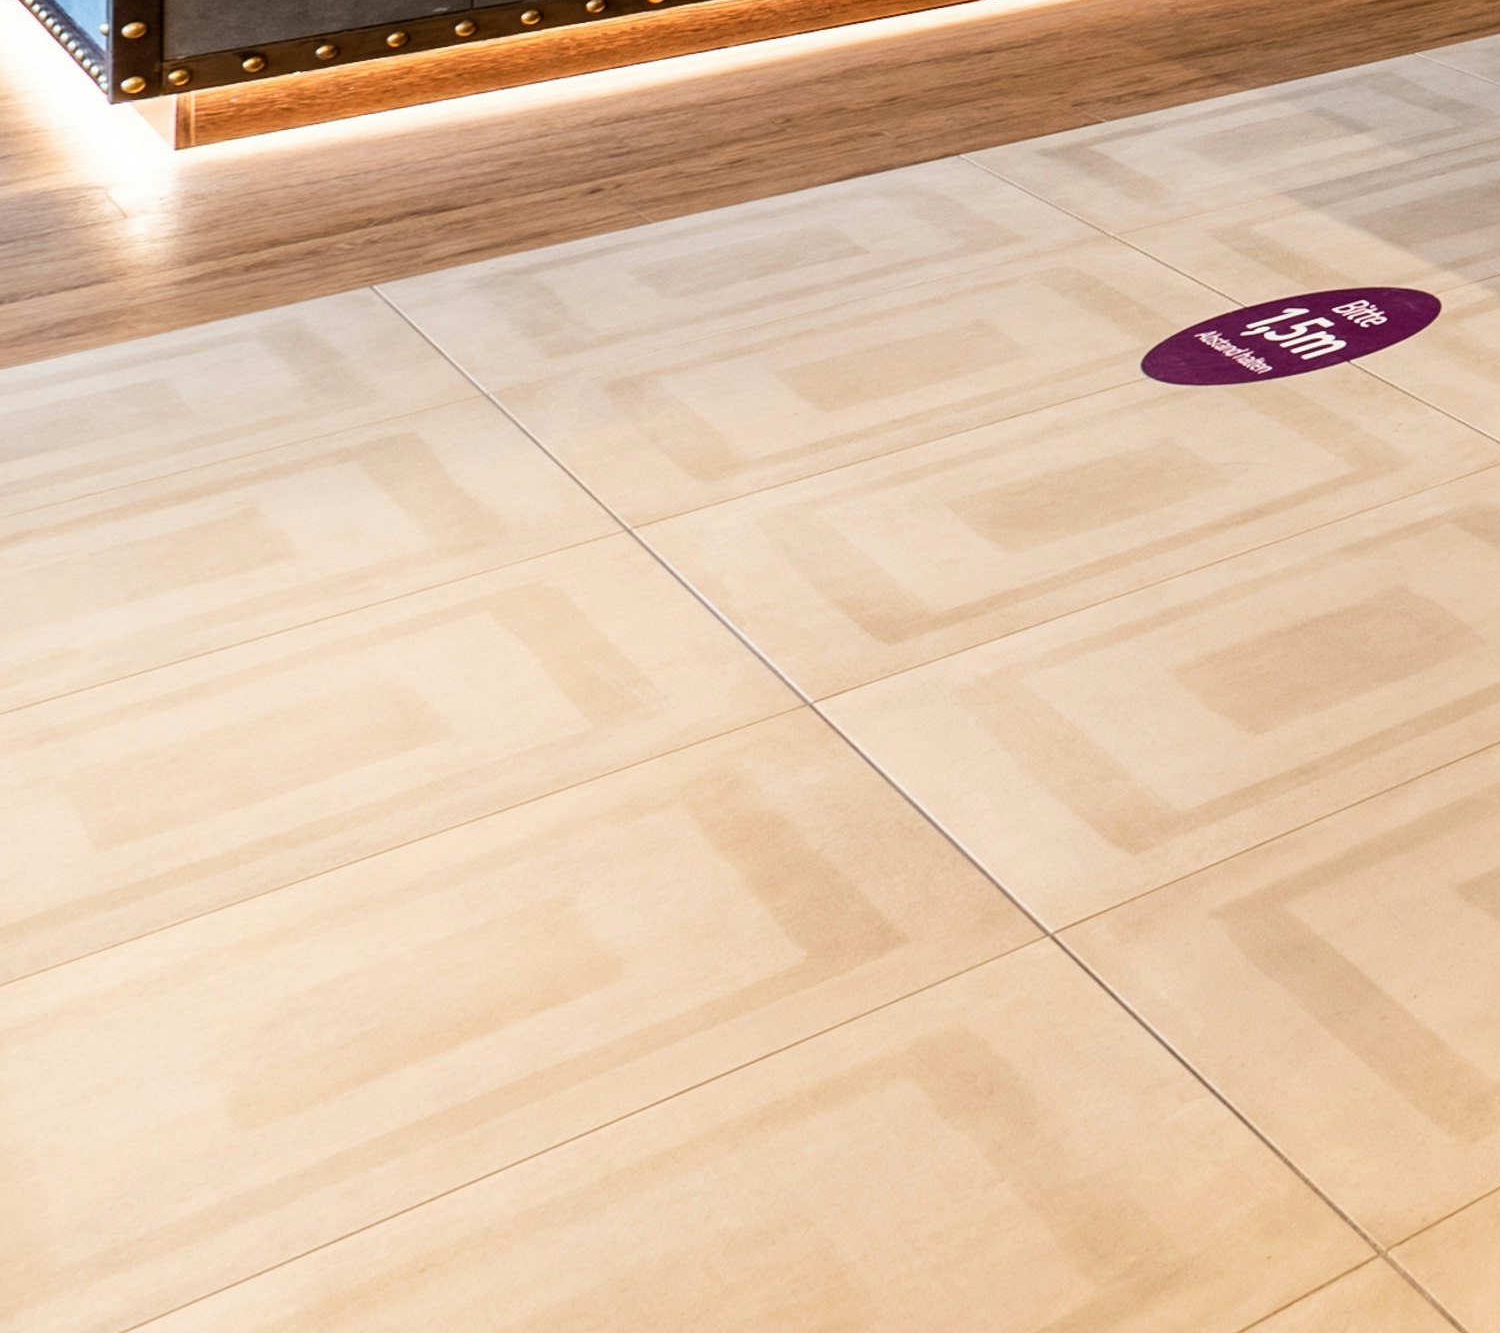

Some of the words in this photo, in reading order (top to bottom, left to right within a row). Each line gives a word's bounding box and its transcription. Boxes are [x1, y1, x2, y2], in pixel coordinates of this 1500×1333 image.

[1332, 299, 1387, 328] Bitte
[1194, 330, 1242, 360] Abstand
[1232, 347, 1272, 374] halten
